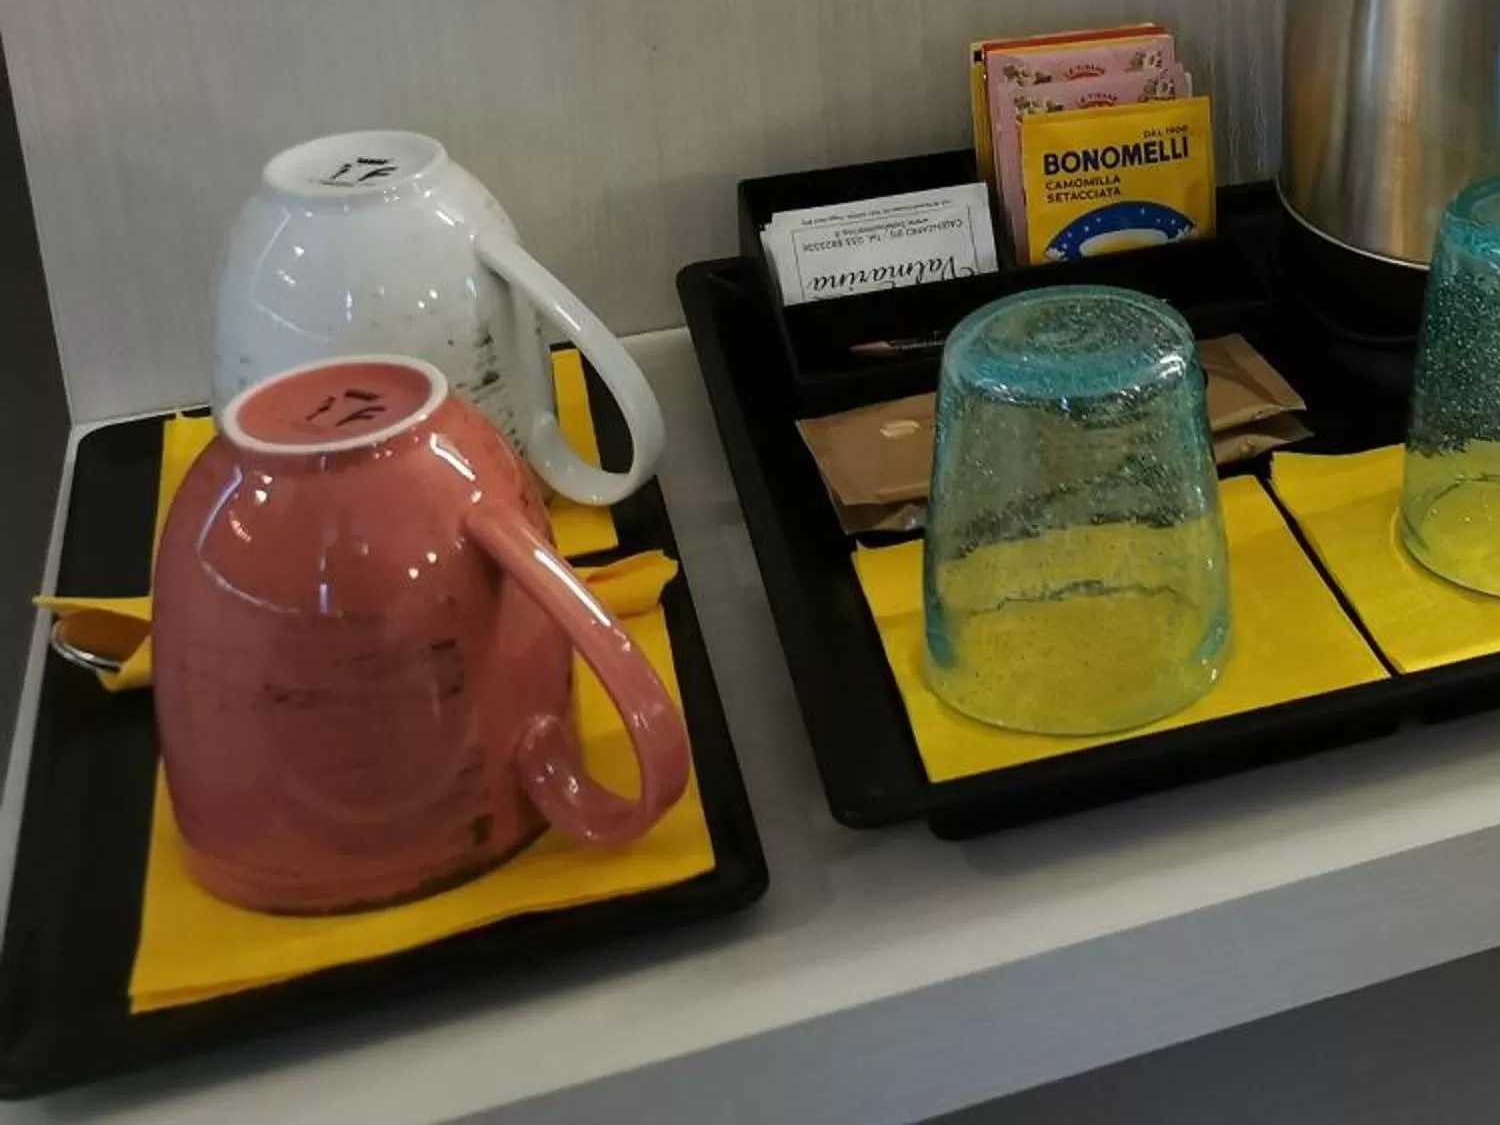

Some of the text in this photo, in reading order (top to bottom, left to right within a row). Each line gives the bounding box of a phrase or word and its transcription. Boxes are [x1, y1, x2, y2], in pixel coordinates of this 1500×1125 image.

[1043, 136, 1189, 176] BONOMELLI
[1045, 175, 1121, 192] CAMOMILLA
[1046, 187, 1121, 204] SETACCIATA
[808, 255, 975, 291] Valmarina
